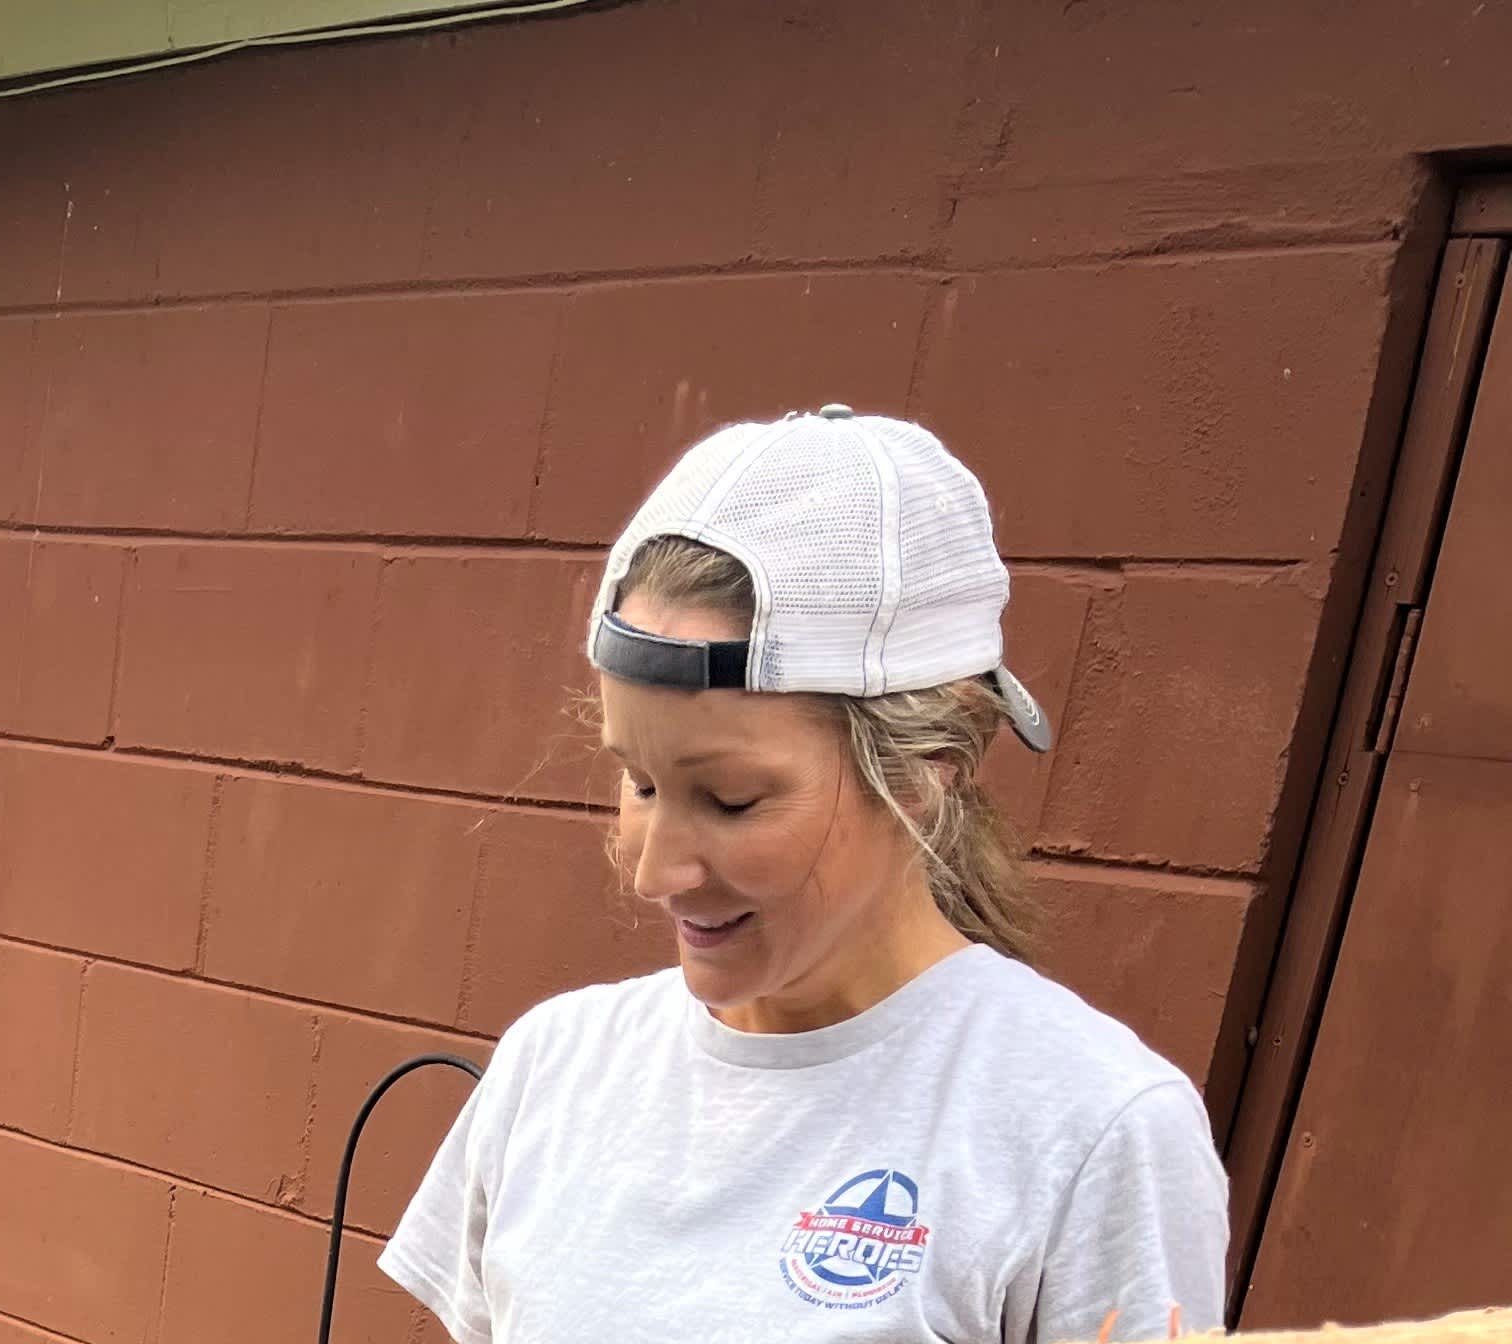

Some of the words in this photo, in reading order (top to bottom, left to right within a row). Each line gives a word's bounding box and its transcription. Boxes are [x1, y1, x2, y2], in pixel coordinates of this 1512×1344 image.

[808, 1217, 849, 1229] HOME
[851, 1221, 915, 1241] SERVICE
[780, 1229, 926, 1273] HEROES
[825, 1300, 873, 1310] WITHOUT
